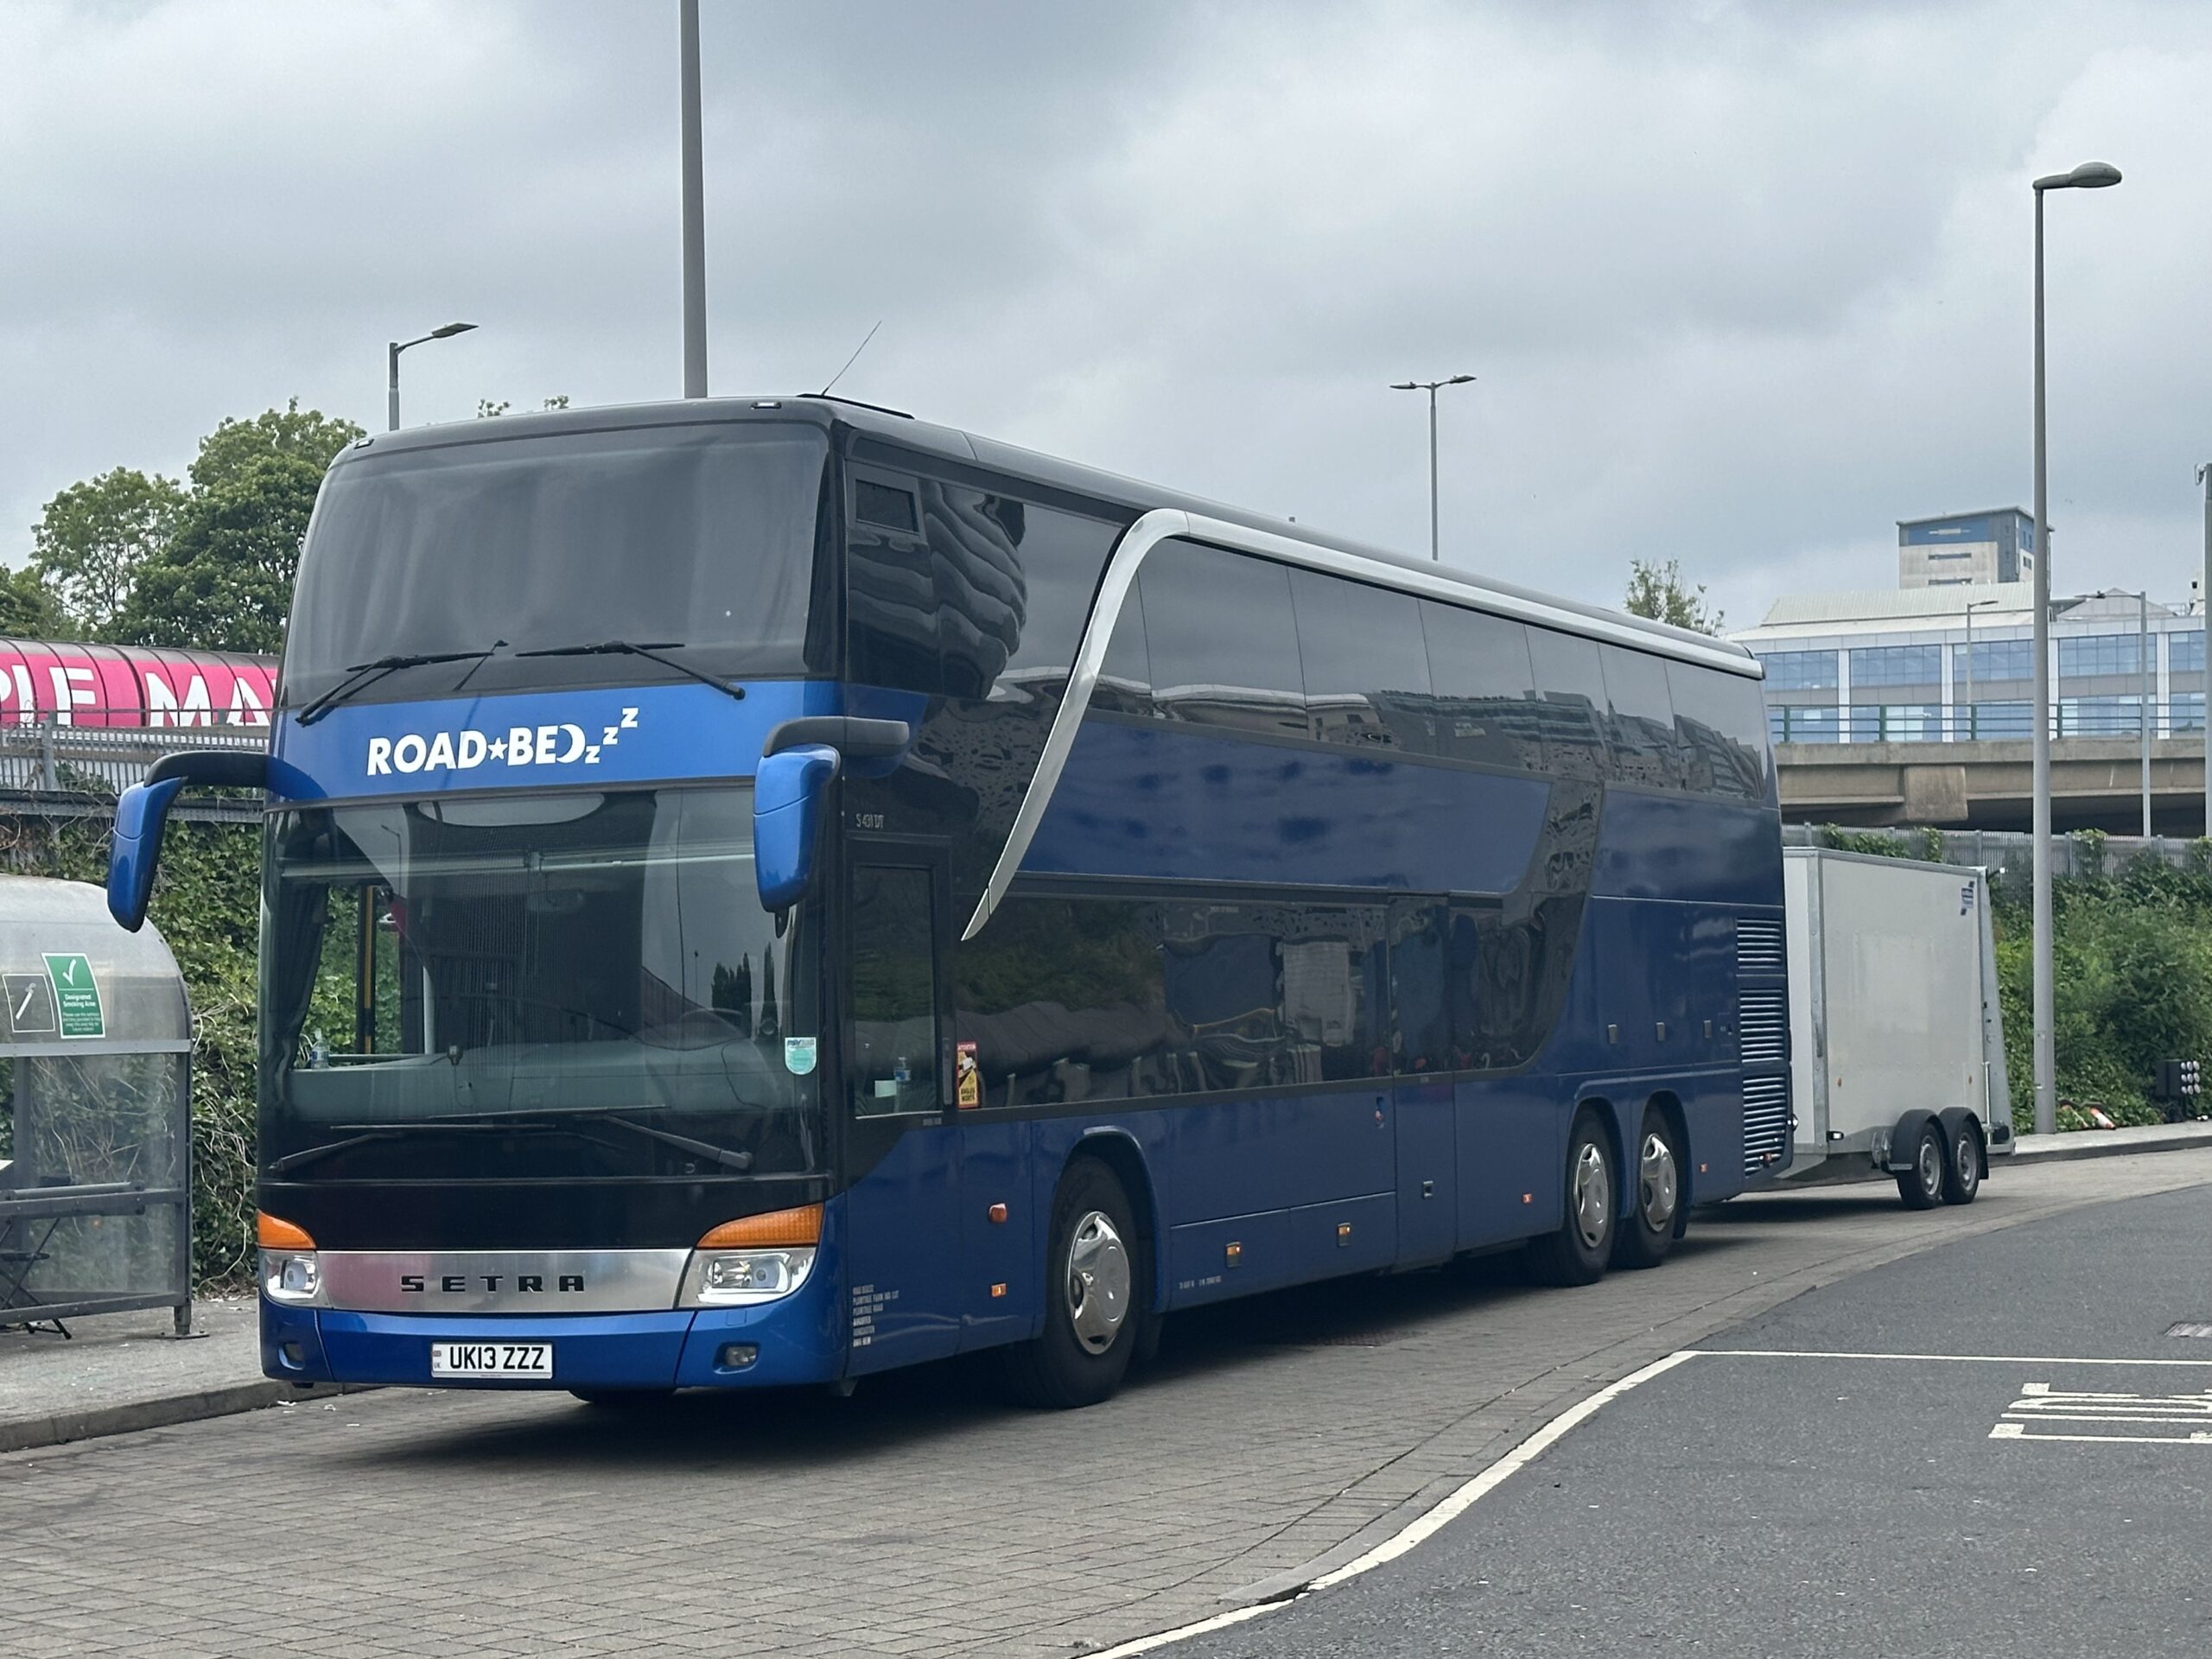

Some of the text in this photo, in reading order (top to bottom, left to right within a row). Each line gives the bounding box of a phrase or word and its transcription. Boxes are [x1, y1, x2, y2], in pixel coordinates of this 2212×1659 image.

[144, 672, 276, 727] MA
[366, 730, 486, 776] ROAD
[401, 1275, 585, 1293] SETRA
[449, 1346, 544, 1370] UK13 ZZZ
